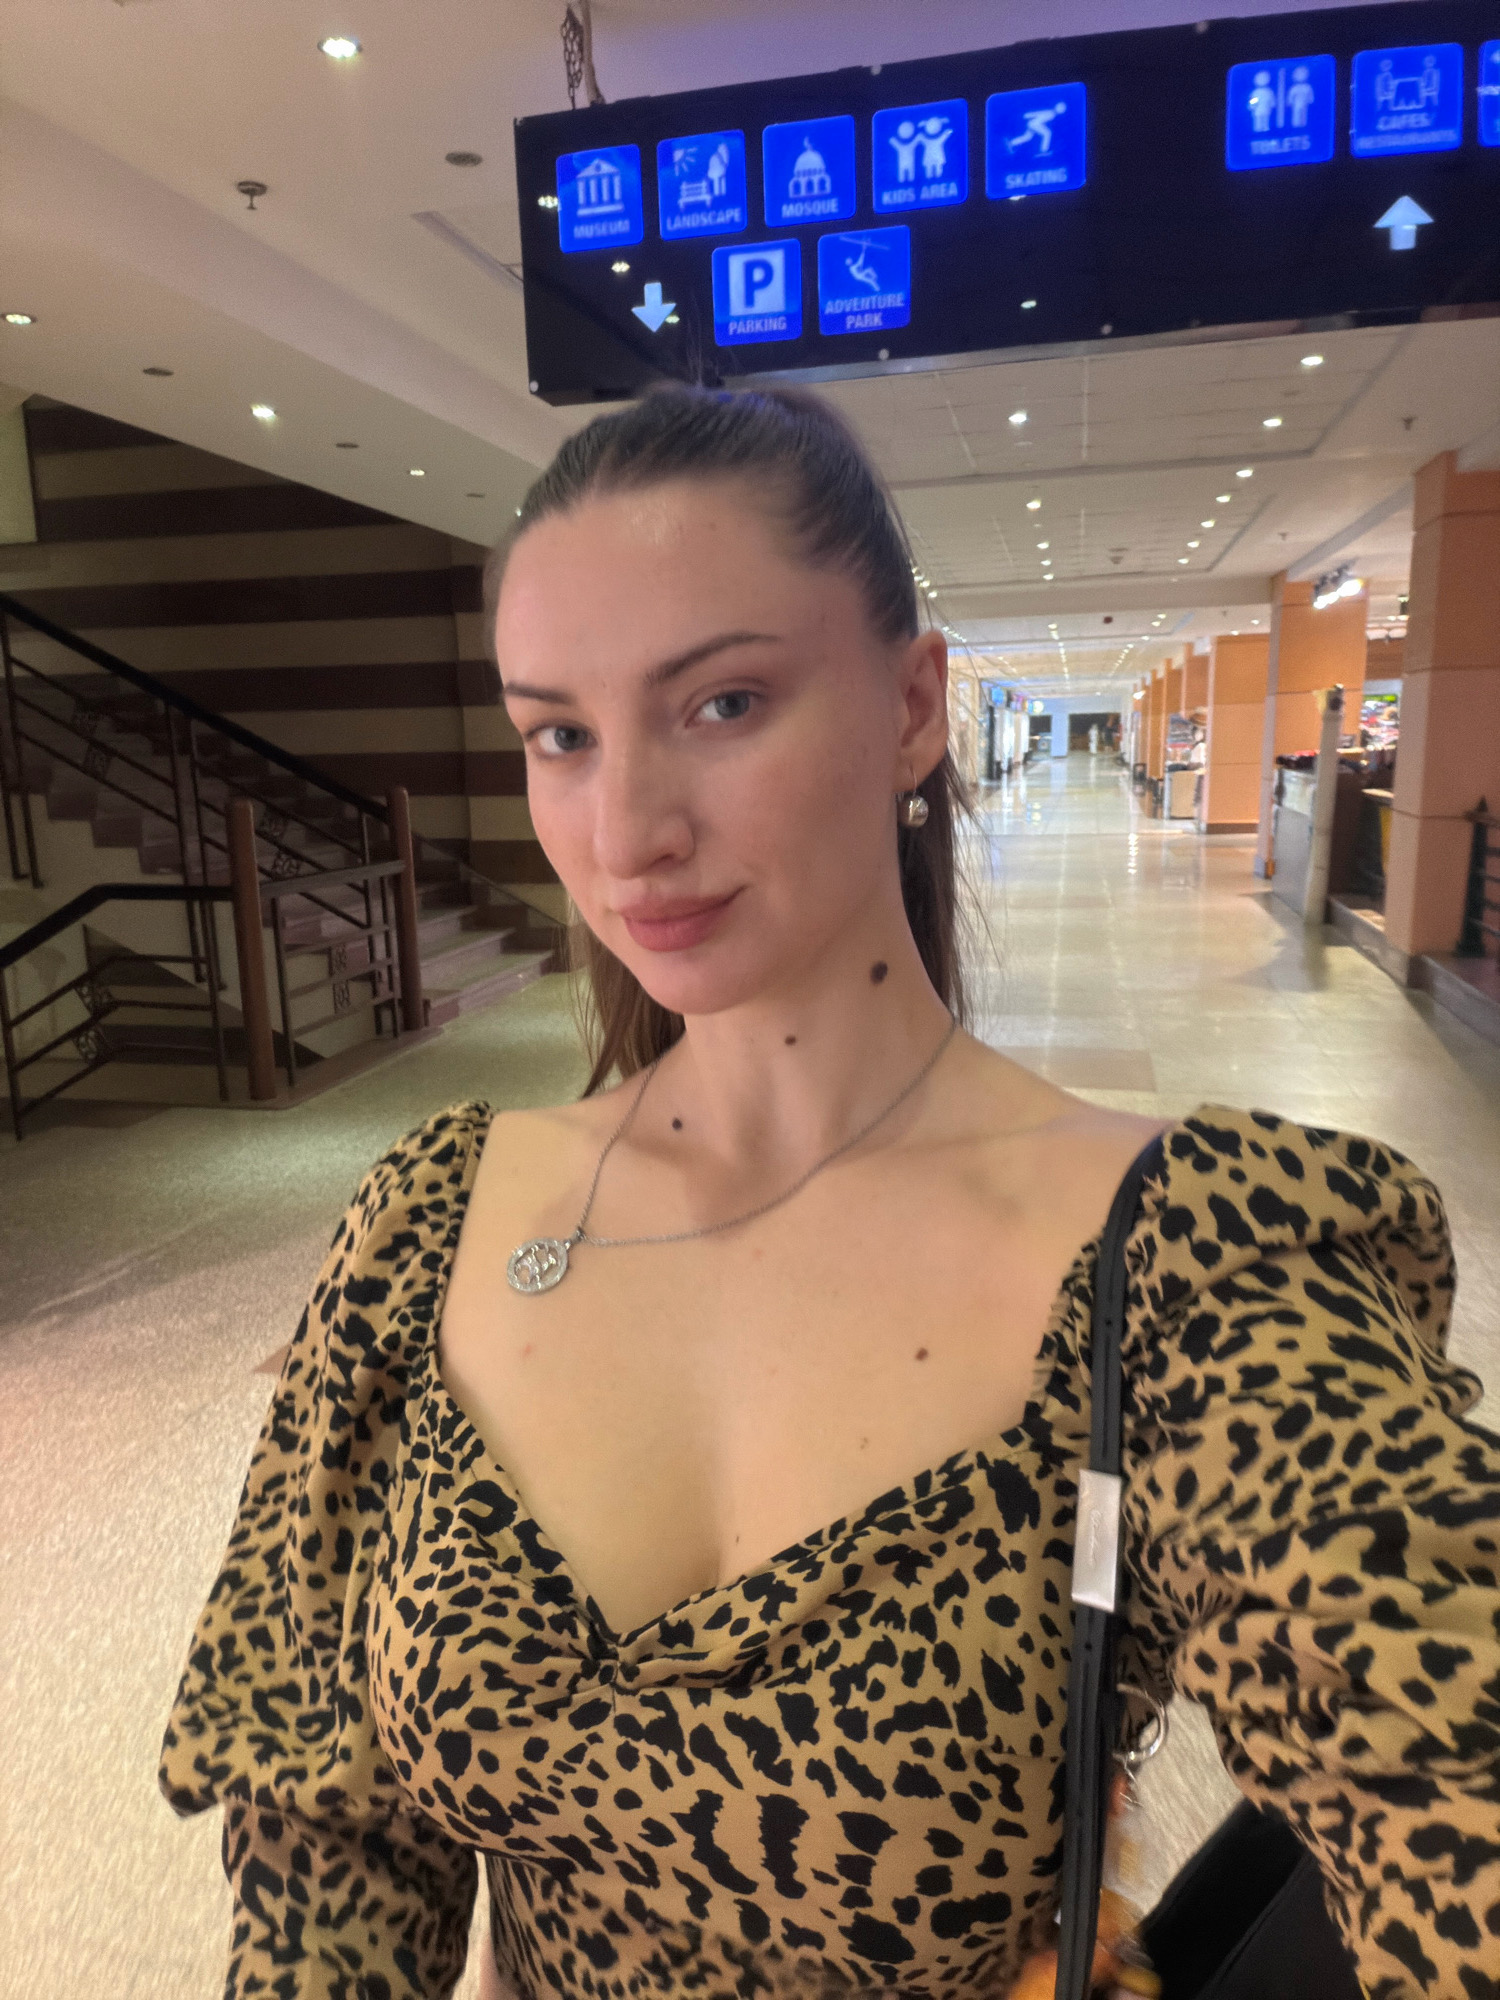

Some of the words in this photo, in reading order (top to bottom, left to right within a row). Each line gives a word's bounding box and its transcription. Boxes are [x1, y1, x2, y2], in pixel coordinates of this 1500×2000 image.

[1005, 168, 1067, 189] SKATING
[882, 188, 915, 205] KIDS
[920, 182, 958, 199] AREA
[782, 198, 839, 218] MOSQUE
[573, 219, 630, 239] MUSEUM
[666, 207, 742, 231] LANDSCAPE
[744, 259, 774, 308] P
[824, 293, 904, 315] ADVENTURE
[728, 316, 787, 336] PARKING
[846, 312, 883, 330] PARK
